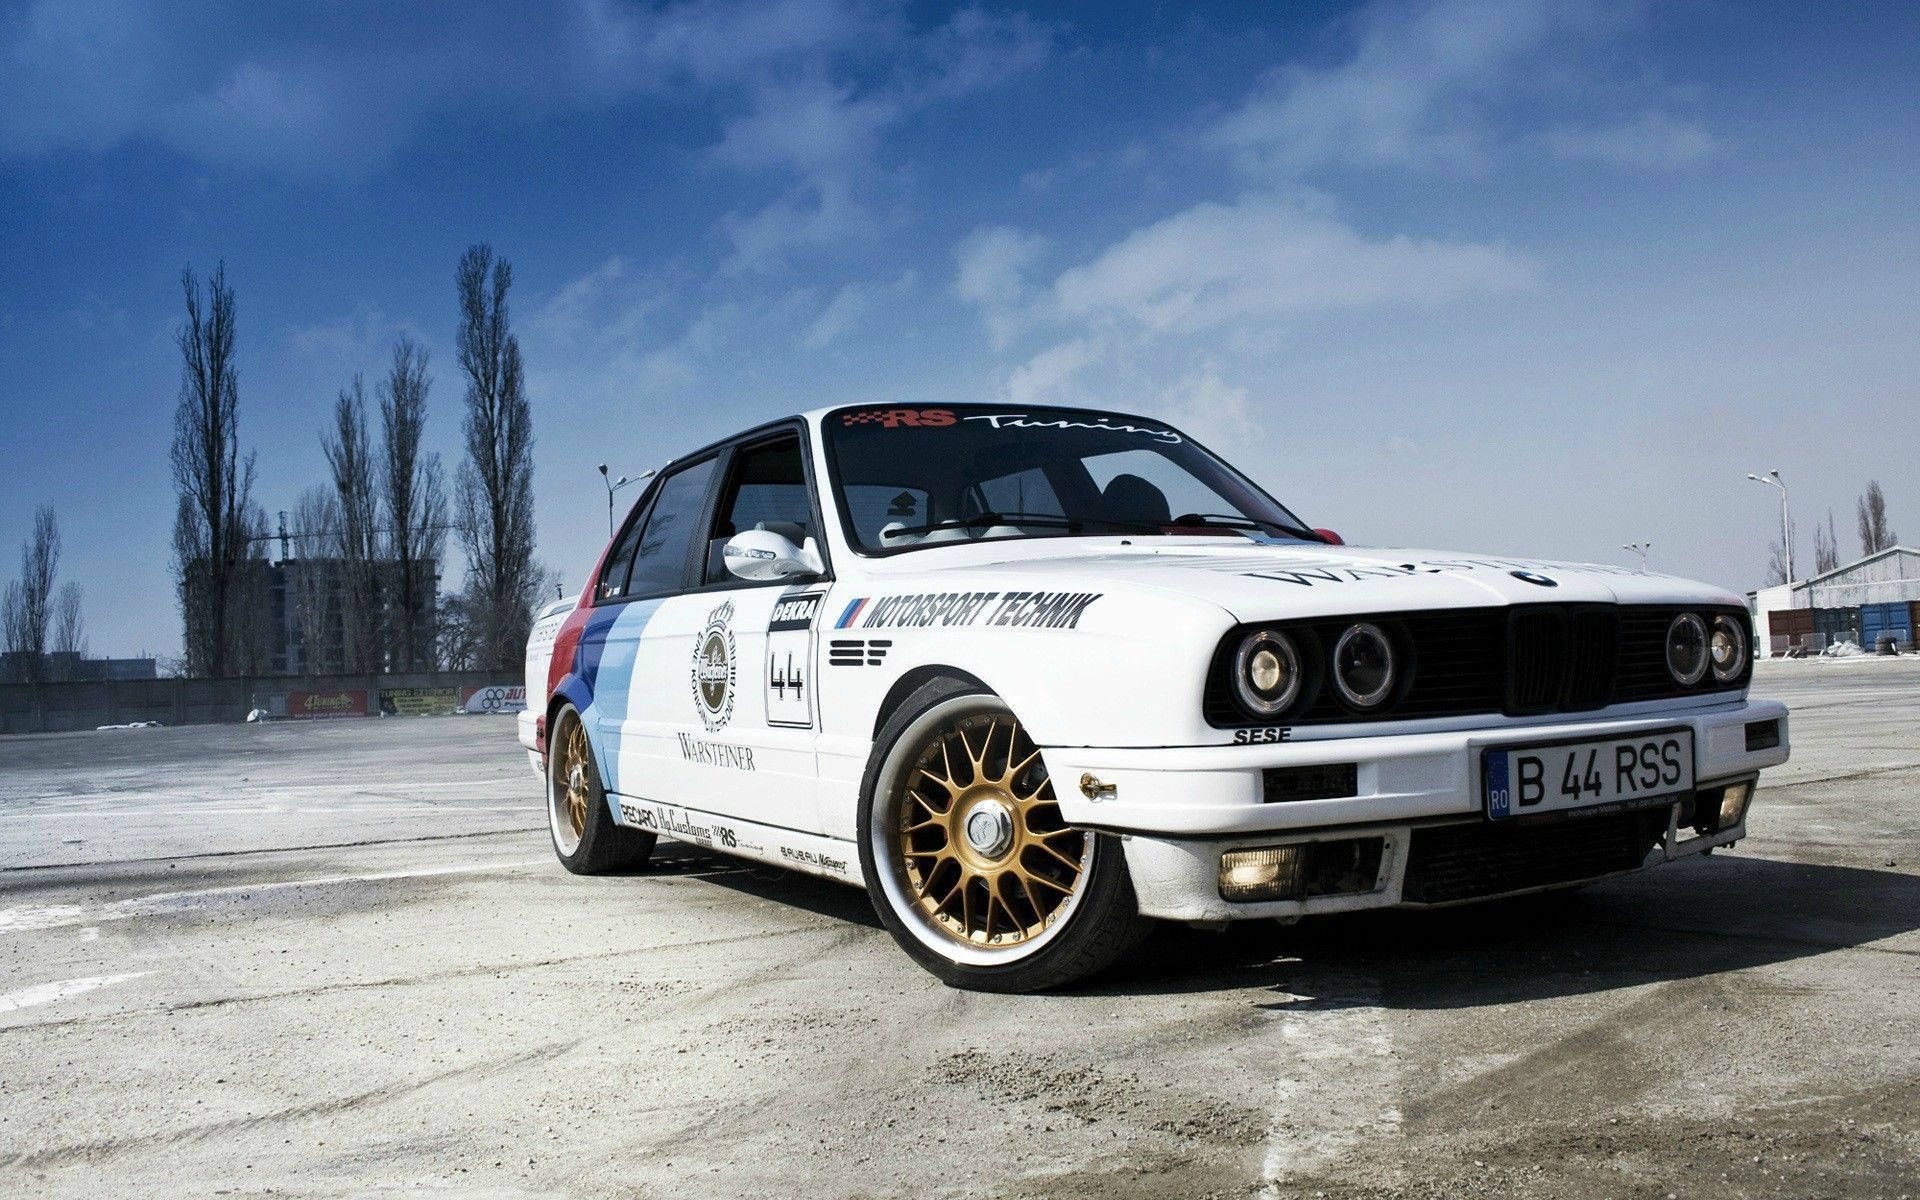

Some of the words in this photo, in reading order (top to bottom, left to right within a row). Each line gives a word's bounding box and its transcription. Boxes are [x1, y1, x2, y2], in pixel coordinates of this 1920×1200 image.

[884, 409, 957, 428] RS
[963, 414, 1183, 444] Tuning
[772, 600, 817, 622] DEKRA
[863, 592, 1000, 628] MOTORSPORT
[985, 591, 1104, 630] TECHNIK
[770, 653, 803, 699] 44
[1233, 727, 1292, 744] SESE
[677, 732, 756, 771] WARSTEINER
[1517, 756, 1545, 807] B
[1561, 749, 1602, 801] 44
[1615, 739, 1681, 794] RSS
[1491, 789, 1508, 810] RO
[620, 804, 658, 830] RECARO
[719, 826, 737, 848] RS
